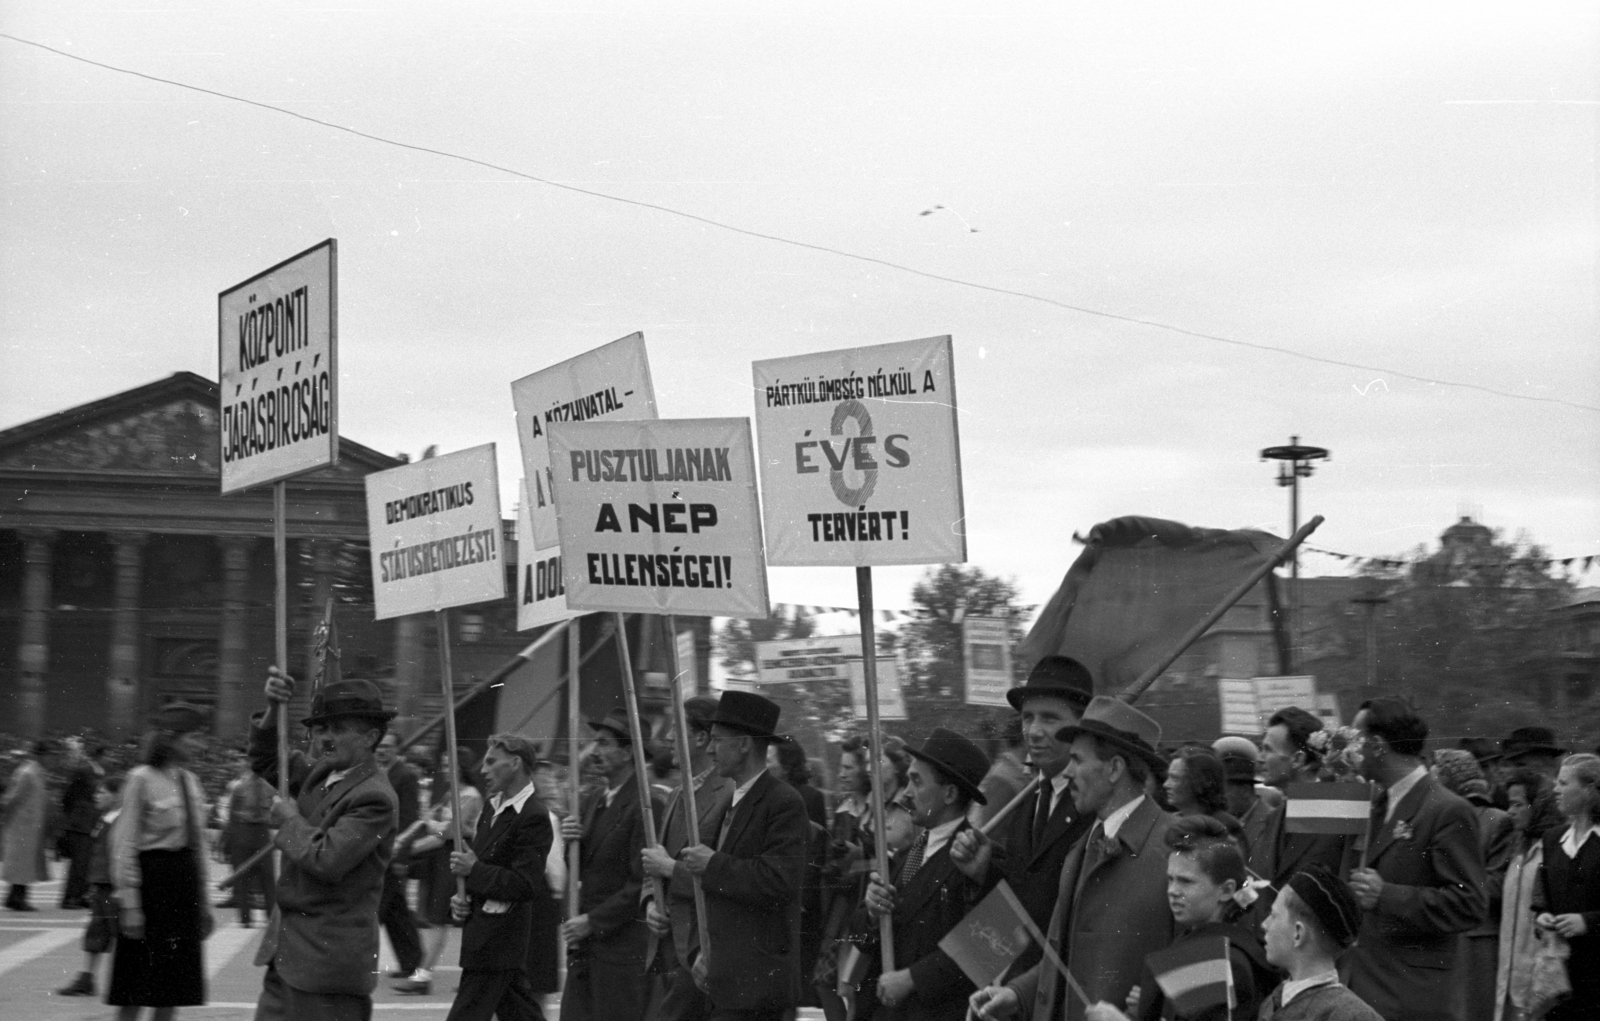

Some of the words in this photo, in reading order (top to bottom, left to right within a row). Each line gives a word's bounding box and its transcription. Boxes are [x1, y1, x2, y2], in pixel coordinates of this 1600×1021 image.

[239, 285, 308, 372] KÖZPONTI
[867, 367, 917, 398] NÉLKÜL
[922, 369, 936, 393] A
[223, 353, 329, 463] JÁRÁSBÍRÓSÁG
[533, 415, 543, 439] A
[570, 447, 732, 482] PUSZTULJANAK
[795, 429, 911, 474] ÉVES
[385, 481, 474, 525] DEMOKRATIKUS
[595, 503, 622, 533] A
[628, 491, 718, 533] NÉP
[807, 504, 909, 542] TERVÉRT!
[523, 564, 534, 606] A
[587, 546, 732, 589] ELLENSÉGEI!
